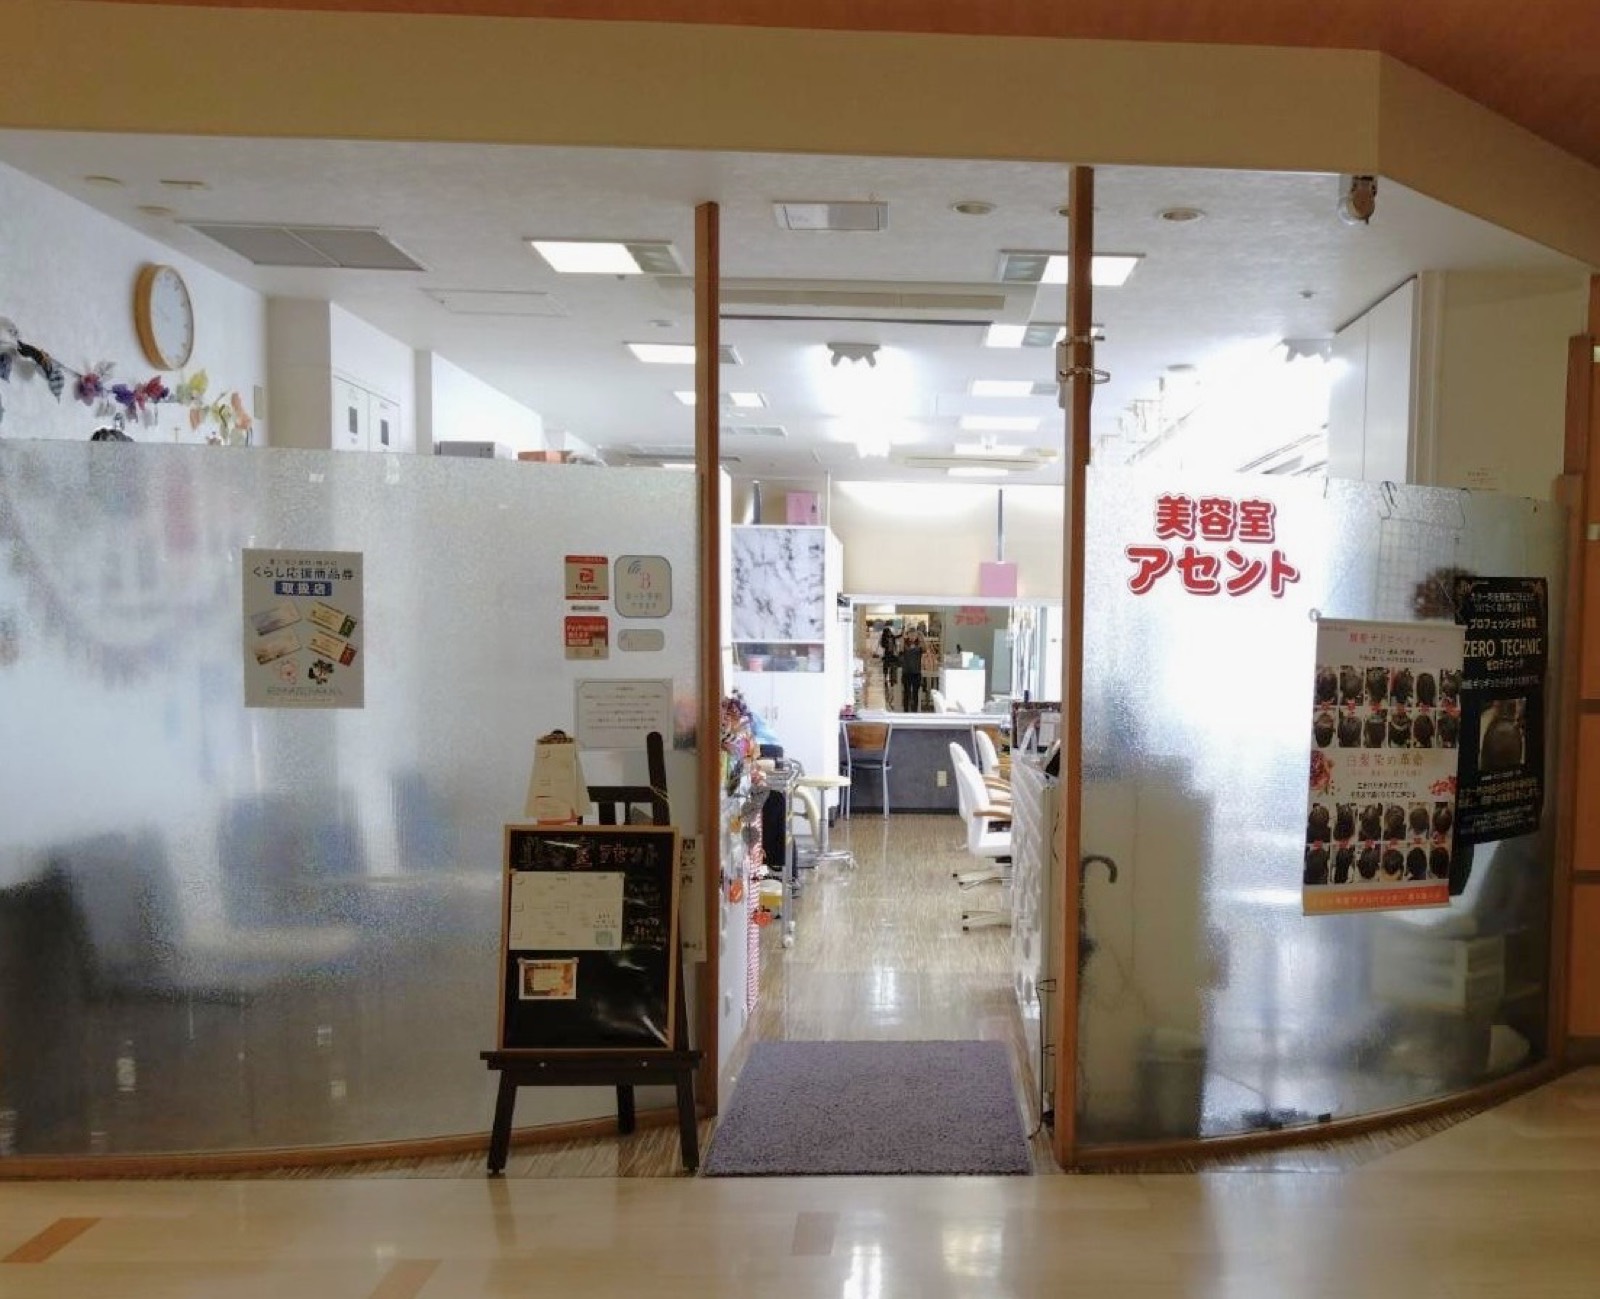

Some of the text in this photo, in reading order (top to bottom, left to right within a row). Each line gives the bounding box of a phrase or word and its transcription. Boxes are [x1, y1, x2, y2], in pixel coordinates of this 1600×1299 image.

[1155, 493, 1277, 543] 美容室
[1125, 544, 1300, 598] アセント
[1463, 637, 1543, 658] ZERO TECHNIC
